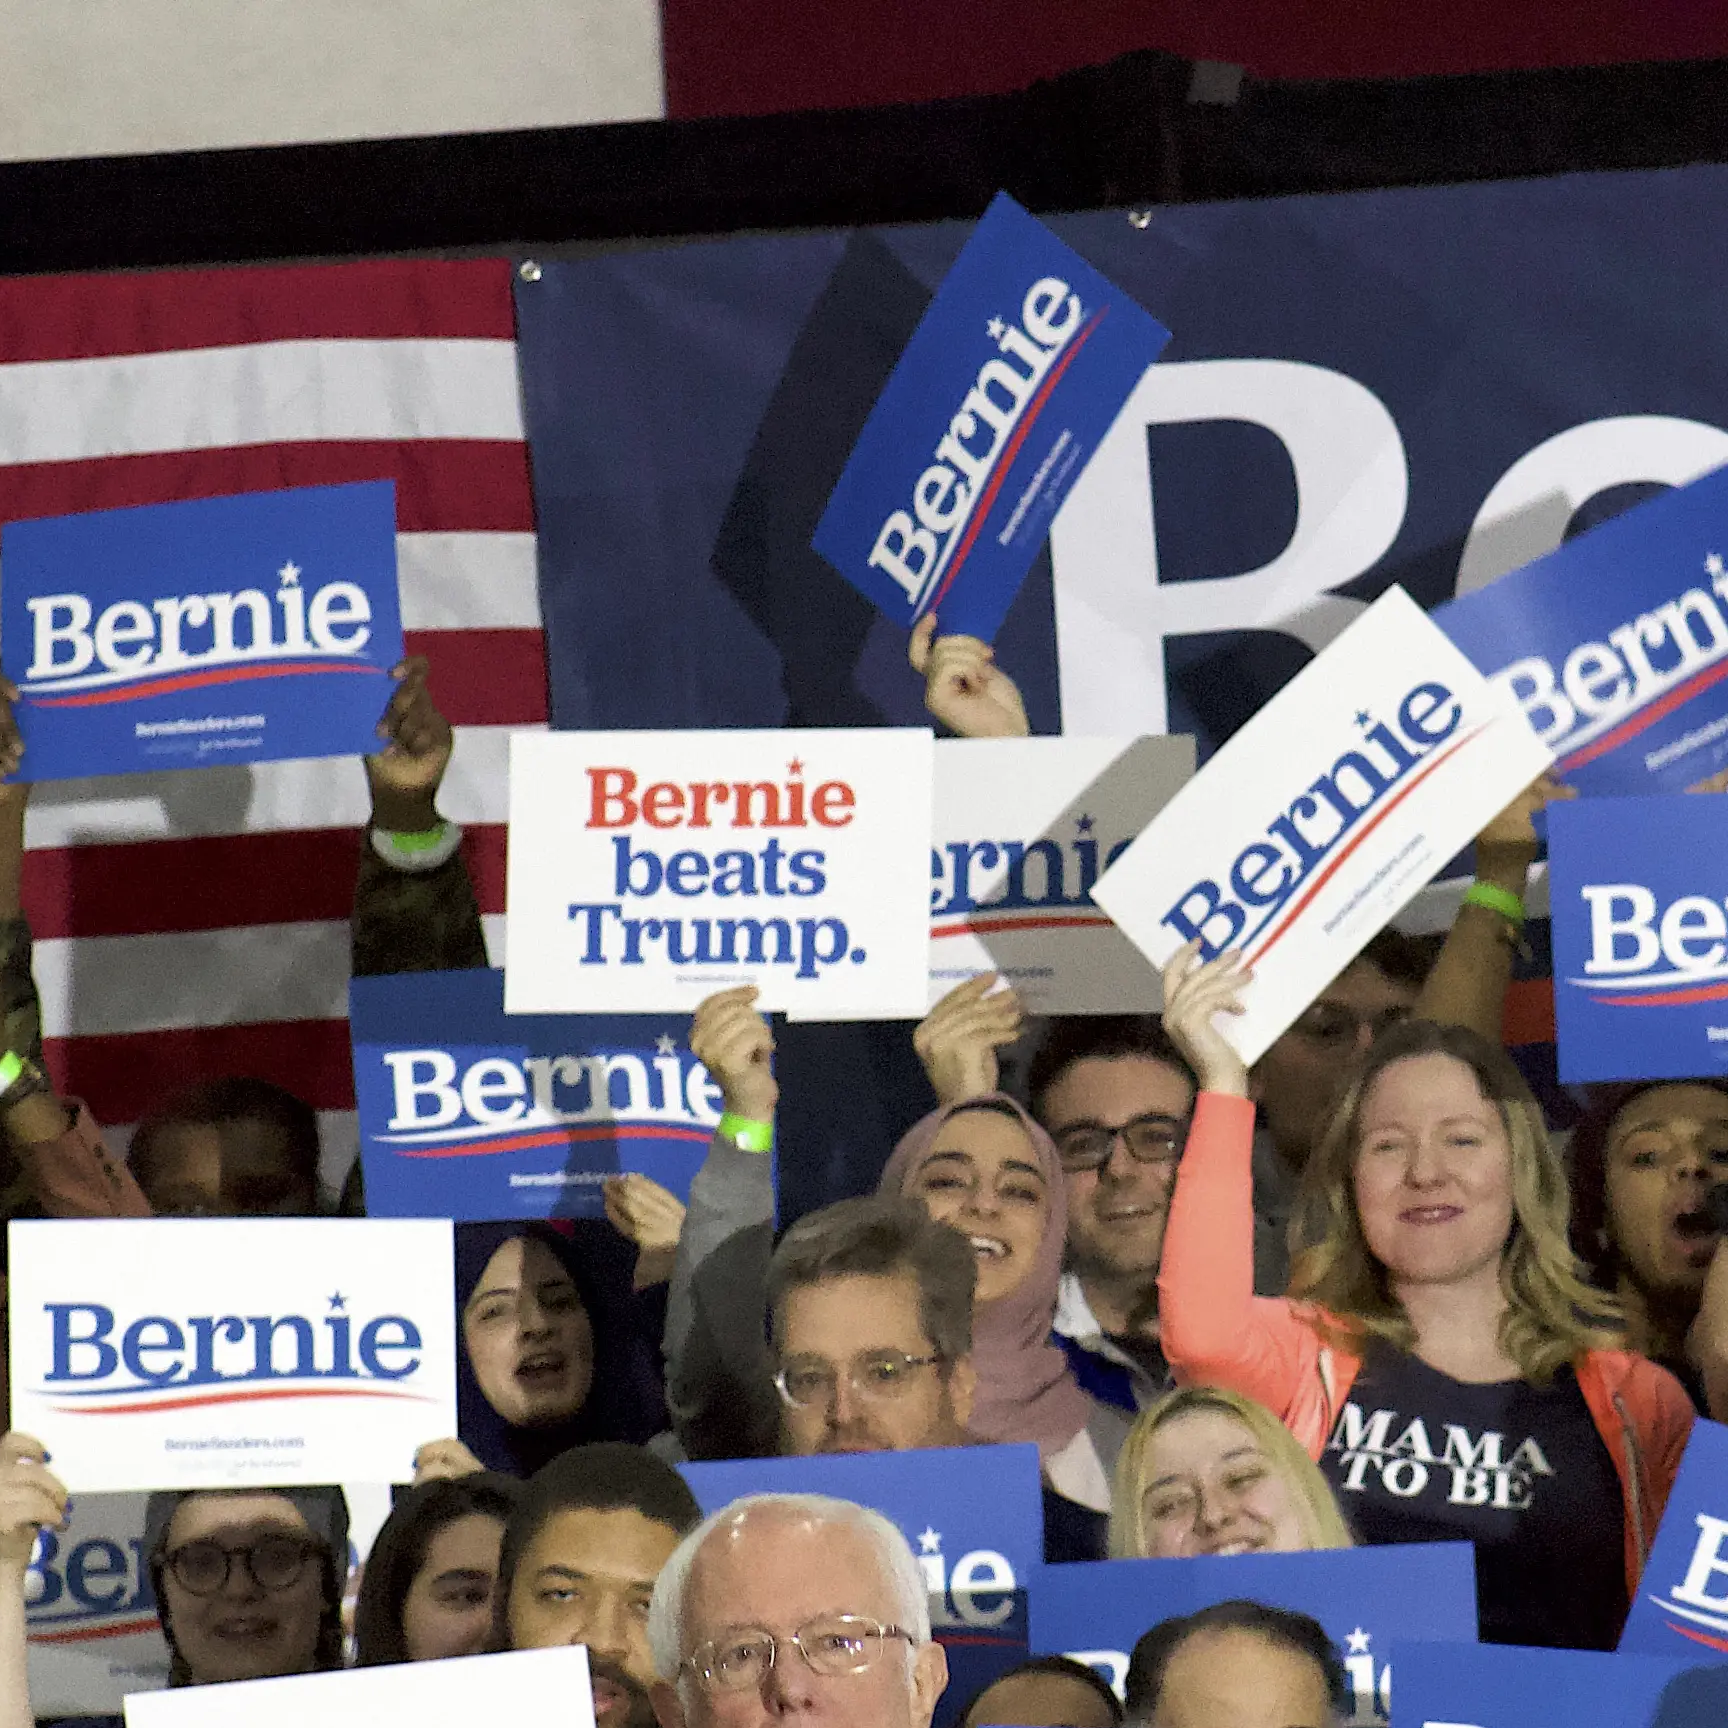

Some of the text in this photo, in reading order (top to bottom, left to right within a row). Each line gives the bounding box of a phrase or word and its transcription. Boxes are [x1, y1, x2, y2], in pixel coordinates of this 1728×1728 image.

[868, 276, 1083, 605] Bernie
[27, 560, 371, 679] Bernie
[585, 757, 855, 829] Bernie
[1160, 681, 1462, 968] Bernie
[612, 836, 827, 896] beats
[569, 903, 867, 979] Trump.
[383, 1033, 724, 1132] Bernie
[43, 1291, 424, 1383] Bernie
[1325, 1402, 1555, 1477] MAMA
[1340, 1451, 1535, 1511] TO BE
